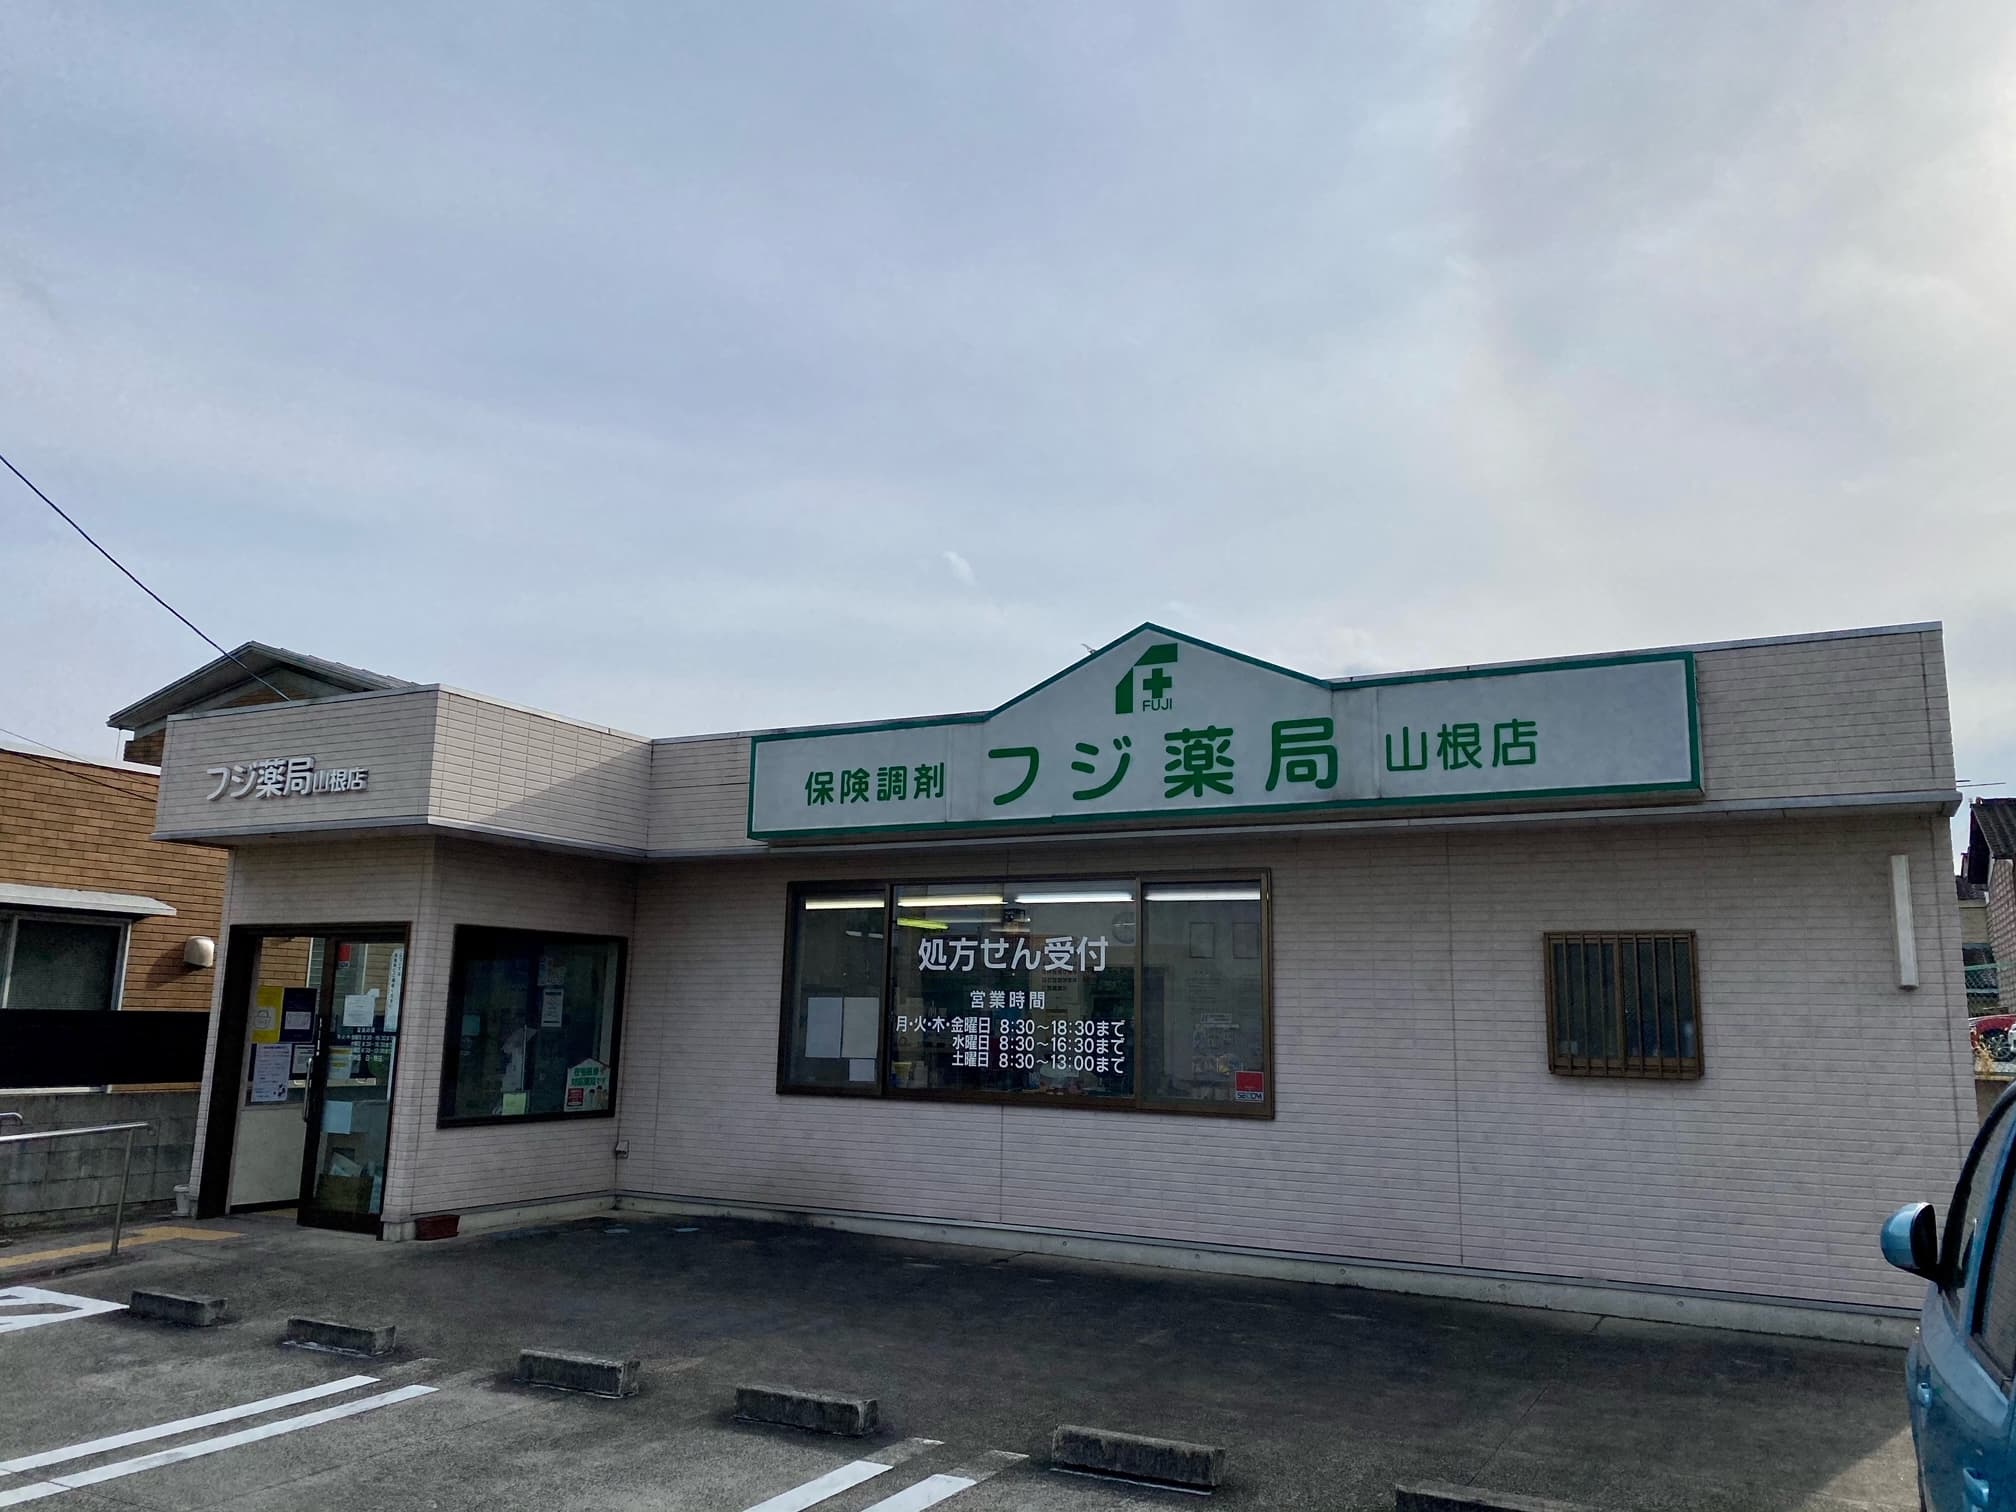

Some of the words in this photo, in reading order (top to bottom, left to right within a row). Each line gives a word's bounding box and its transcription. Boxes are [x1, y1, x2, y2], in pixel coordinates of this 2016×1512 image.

[1142, 699, 1174, 712] FUJI
[805, 763, 946, 806] 保険調剤
[987, 716, 1339, 806] フジ薬局
[1385, 718, 1538, 772] 山根店
[918, 936, 1109, 972] 処方せん受付
[970, 990, 1046, 1010] 営業時間
[952, 1034, 990, 1051] 水曜日
[952, 1051, 989, 1068] 土曜日
